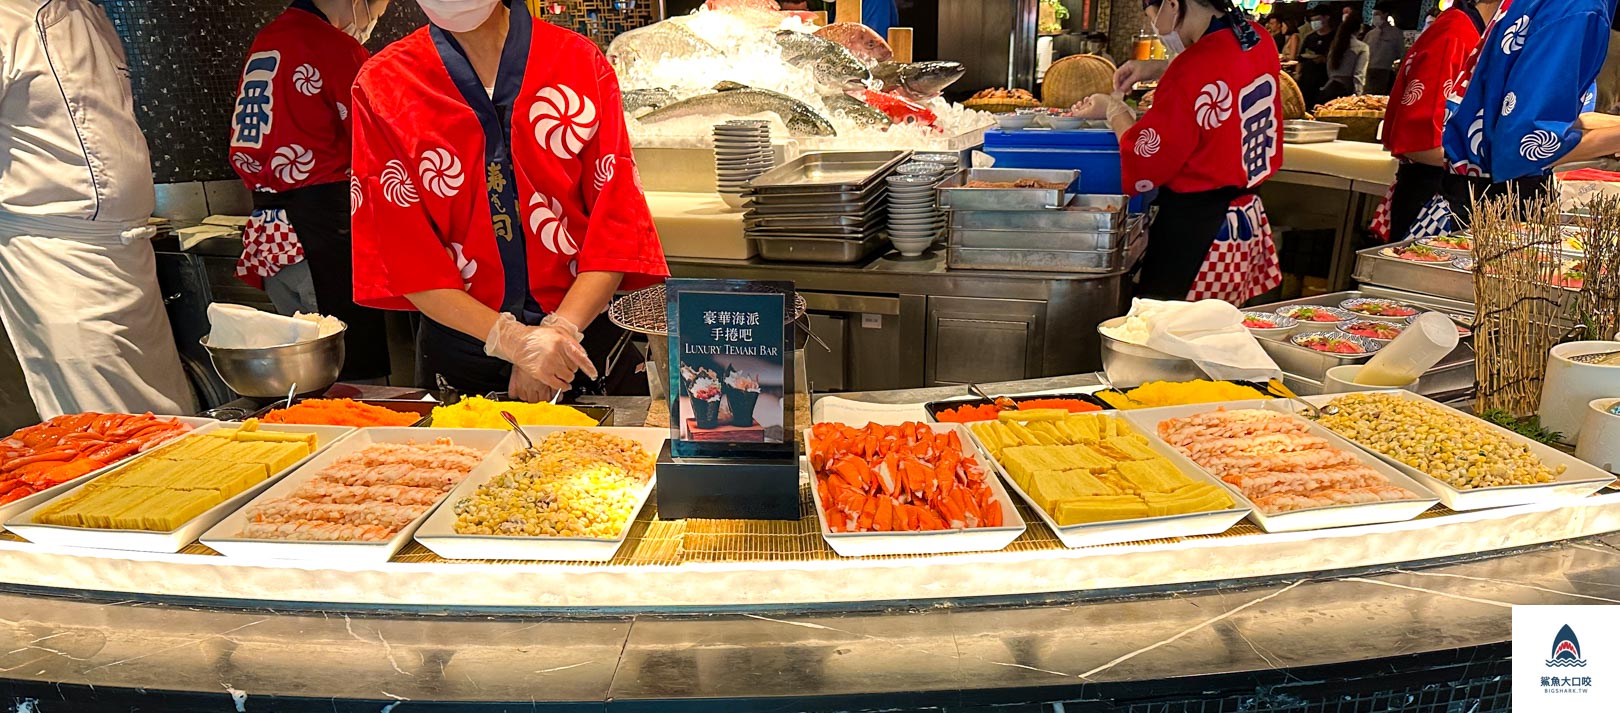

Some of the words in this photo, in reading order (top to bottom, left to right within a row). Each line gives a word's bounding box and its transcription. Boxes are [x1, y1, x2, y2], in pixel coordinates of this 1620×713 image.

[233, 52, 279, 147] 一番
[1239, 75, 1276, 186] 一番
[703, 311, 760, 326] 豪華海派
[710, 327, 753, 342] 手捲吧
[685, 343, 722, 355] LUXURY
[724, 344, 757, 356] TEMAKI
[759, 345, 778, 356] BAR
